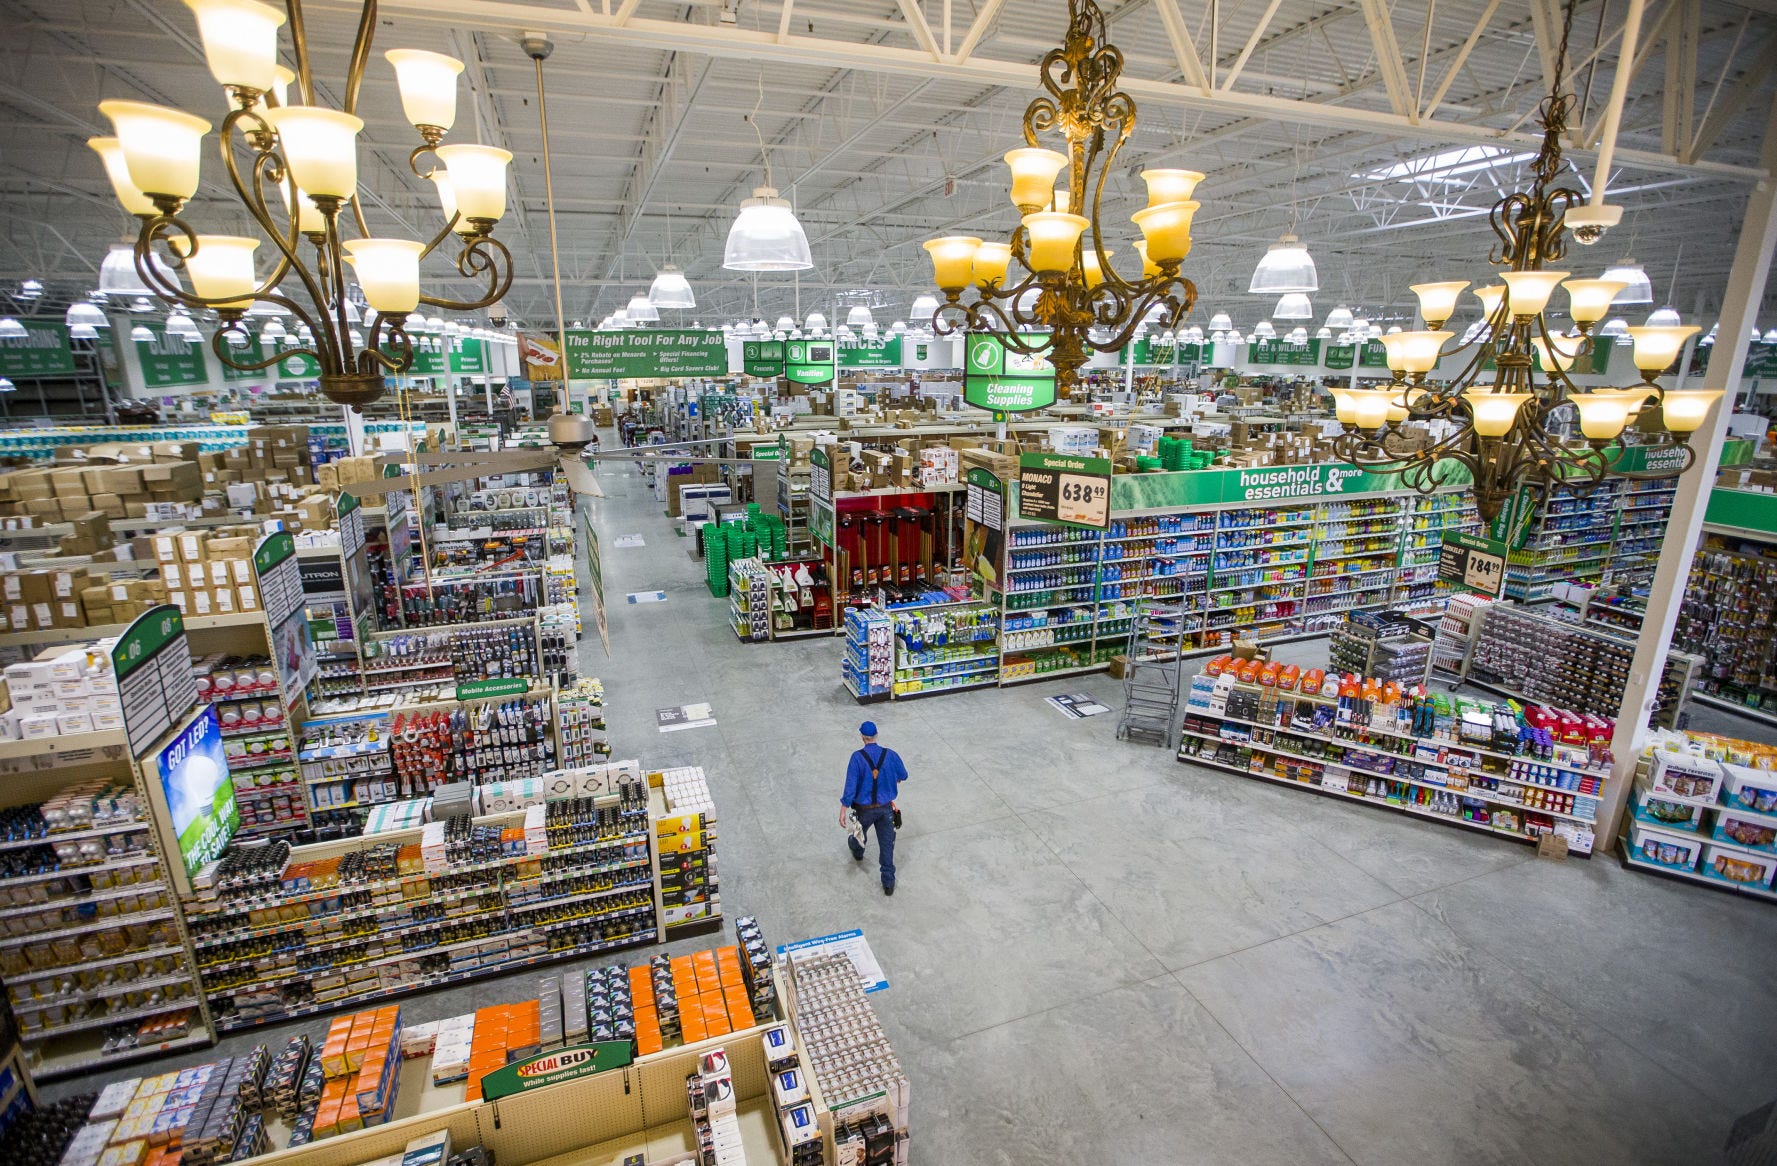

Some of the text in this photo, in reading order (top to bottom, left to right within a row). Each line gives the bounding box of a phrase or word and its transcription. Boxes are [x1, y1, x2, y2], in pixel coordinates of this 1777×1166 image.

[568, 334, 722, 348] The Right Tool For Any Job
[837, 335, 886, 350] ANCES
[1278, 344, 1311, 352] WILDLIFE
[1368, 344, 1387, 353] FUR
[796, 369, 824, 377] Vanities
[986, 383, 1034, 396] Cleaning
[986, 394, 1033, 407] Supplies
[755, 450, 774, 458] Special
[1645, 446, 1686, 459] househo
[1043, 458, 1086, 469] Special Order
[1646, 457, 1687, 470] essentia
[1021, 472, 1053, 485] MONACO
[1240, 466, 1320, 487] household
[1325, 468, 1363, 492] & more
[1062, 482, 1105, 504] 638 49
[1245, 481, 1323, 500] essentials
[1470, 556, 1491, 576] 784
[1492, 562, 1500, 571] 99
[300, 571, 339, 579] UTRON
[461, 682, 523, 695] Mobile Accessories
[168, 738, 187, 771] GOT
[188, 715, 209, 749] LED?
[186, 796, 234, 870] THE COOL WAY
[200, 823, 233, 866] TO SAVE!
[838, 932, 857, 940] Alarms
[517, 1049, 598, 1077] SPECIAL BUY
[523, 1065, 596, 1088] While supplies last!
